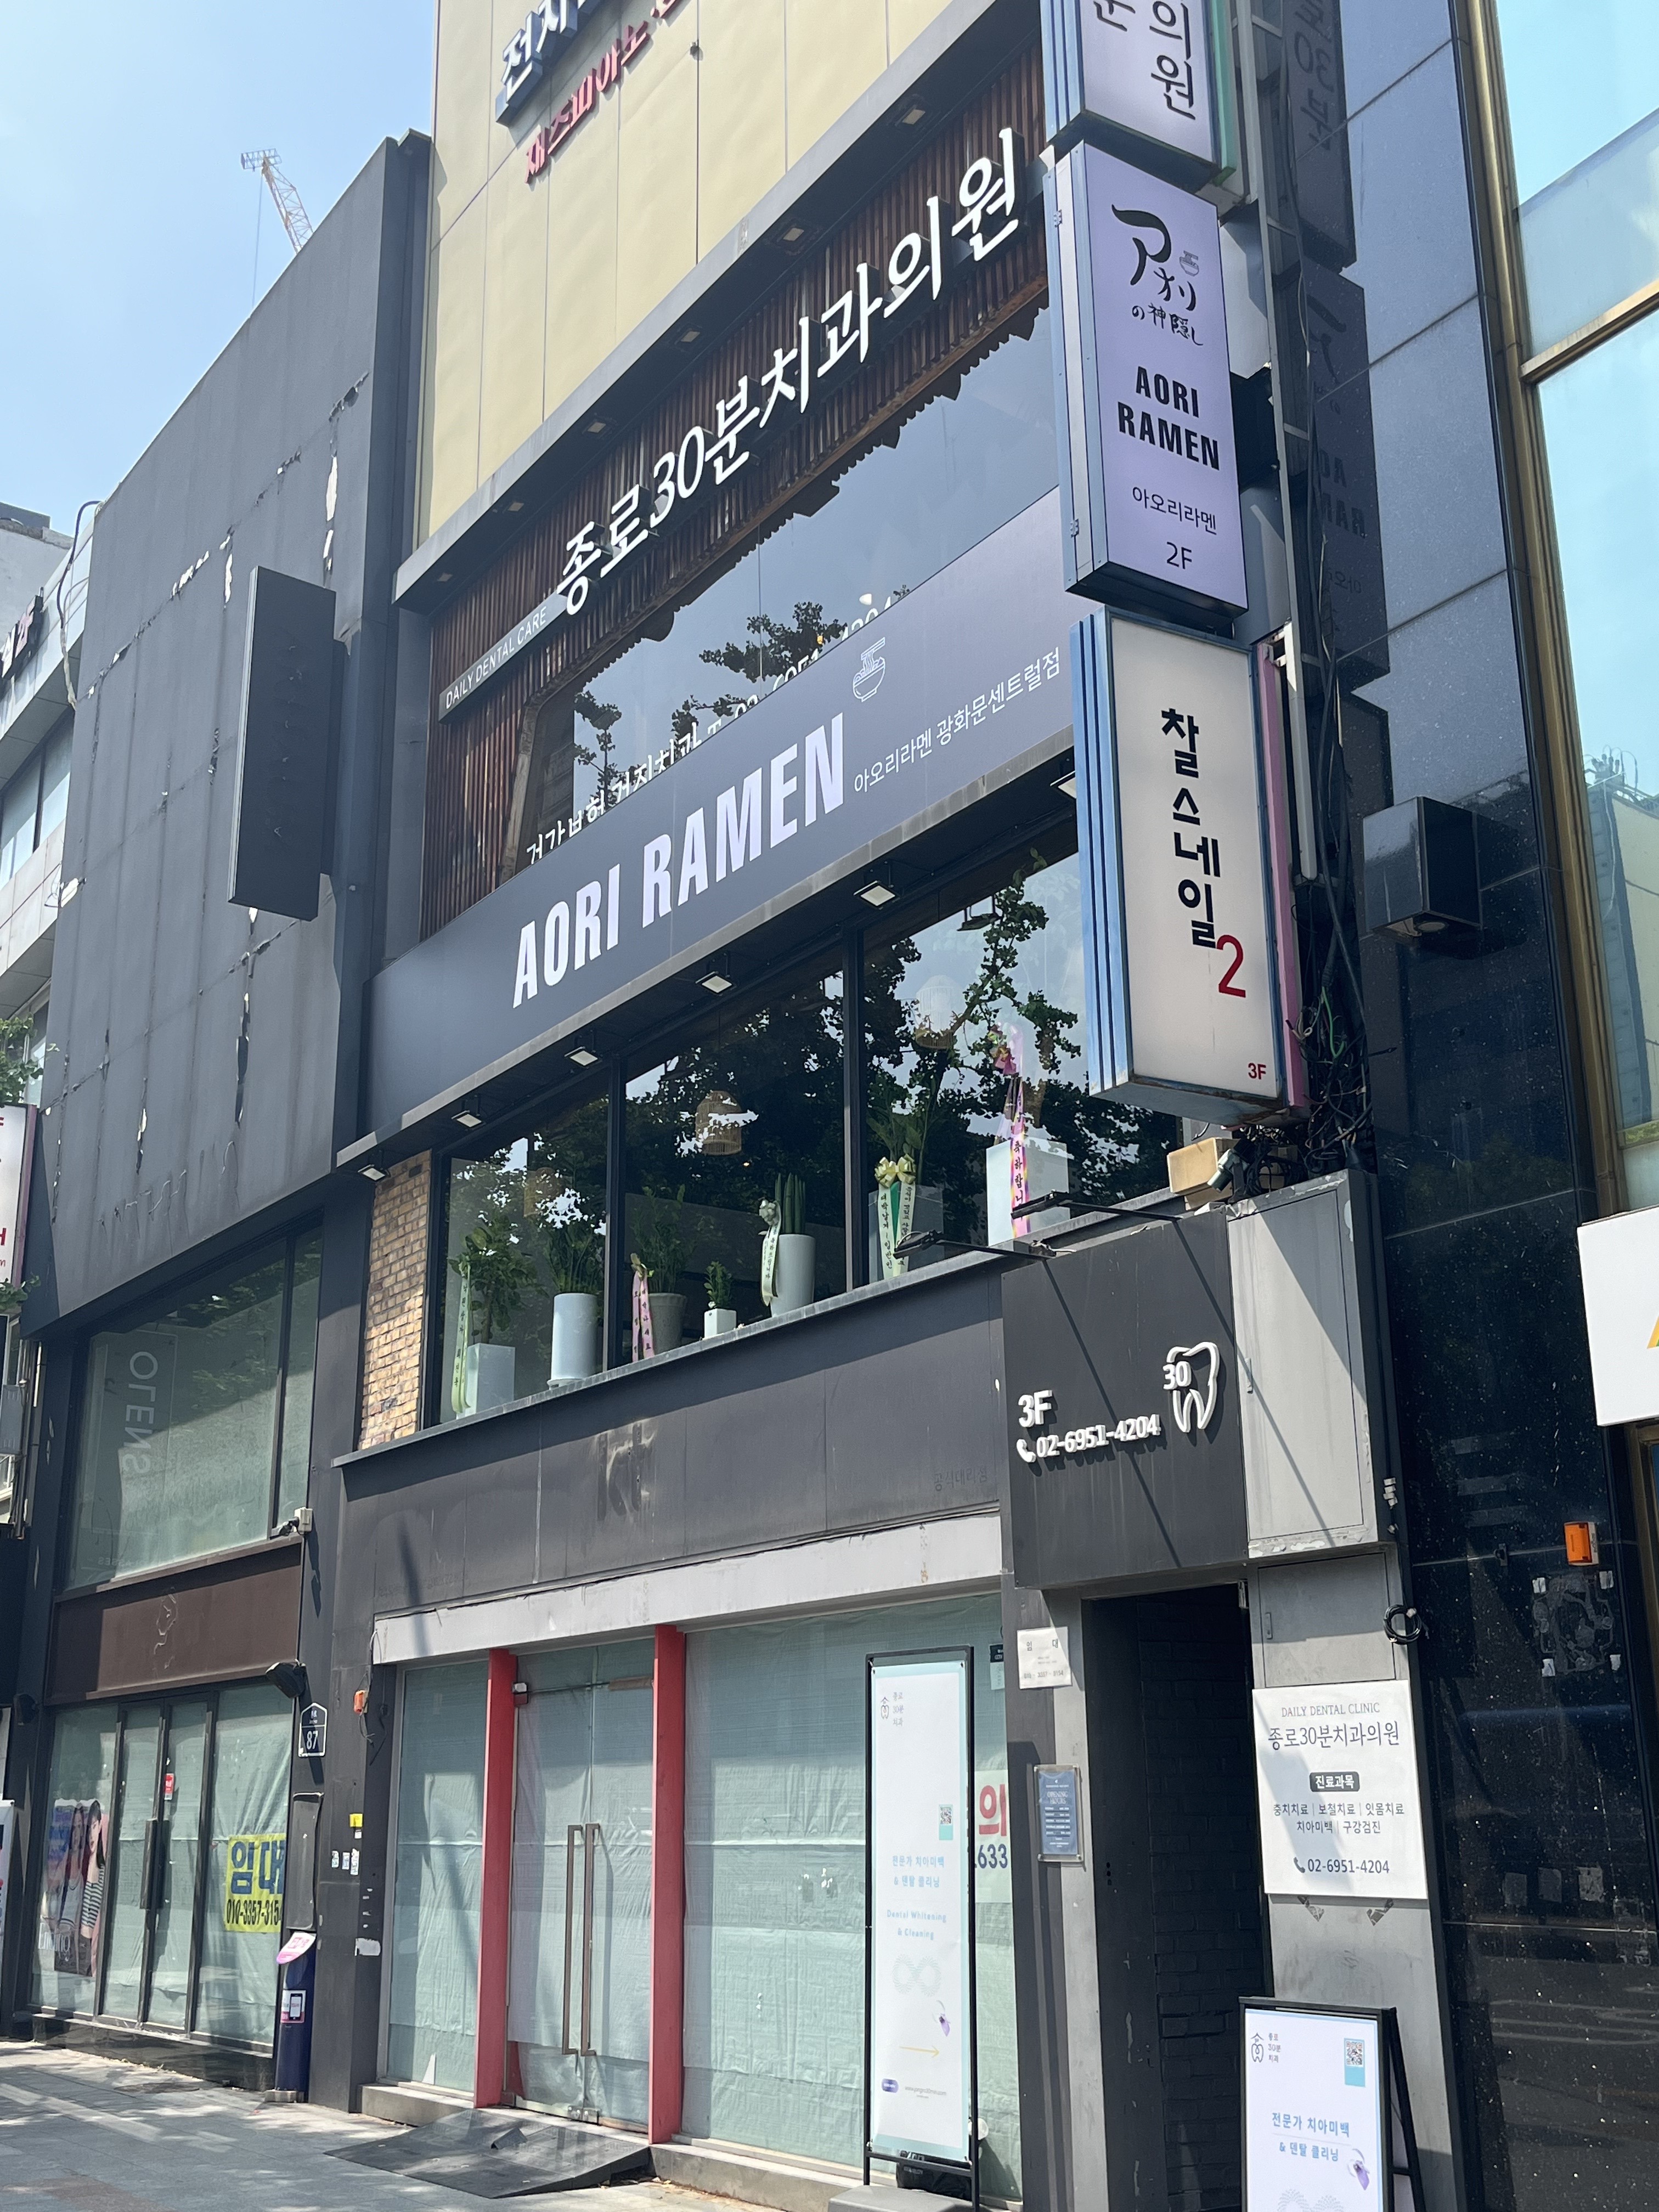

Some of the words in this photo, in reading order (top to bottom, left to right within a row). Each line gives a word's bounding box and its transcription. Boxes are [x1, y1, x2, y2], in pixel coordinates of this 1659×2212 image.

[557, 128, 1020, 616] 종로30분치과의원
[1136, 366, 1199, 418] AORI
[1118, 401, 1220, 471] RAMEN
[1132, 486, 1217, 535] 아오리라멘
[1166, 541, 1193, 570] 2F
[446, 671, 473, 710] DAILY
[476, 637, 515, 684] DENTAL
[517, 606, 547, 645] CARE
[854, 729, 933, 794] 아오리라멘
[936, 647, 1060, 747] 광화문센트럴점
[513, 863, 620, 1008] AORI
[642, 712, 844, 929] RAMEN
[1247, 1062, 1267, 1081] 3F
[1163, 1361, 1192, 1390] 30
[1018, 1390, 1053, 1428] 3F
[1036, 1414, 1163, 1459] 02-6951-4204
[1282, 1705, 1306, 1718] DAILY
[1310, 1704, 1346, 1717] DENTAL
[1348, 1702, 1380, 1715] CLINIC
[306, 1730, 318, 1750] 87
[1267, 1720, 1400, 1751] 종로30분치과의원
[1314, 1775, 1355, 1789] 진료과목
[1273, 1803, 1308, 1816] 충치치료
[1318, 1803, 1355, 1816] 보철치료
[1365, 1803, 1405, 1816] 잇몸치료
[1296, 1820, 1334, 1833] 치아미백
[1342, 1820, 1381, 1834] 구강검진
[231, 1841, 286, 1895] 임대
[892, 1855, 913, 1867] 전문가
[916, 1856, 945, 1869] 치아미백
[1307, 1858, 1390, 1874] 02-6951-4204
[227, 1899, 281, 1926] 010-3357-315
[887, 1909, 909, 1918] Dental
[911, 1911, 947, 1923] Whitening
[905, 1928, 935, 1940] Cleaning
[1268, 2044, 1282, 2053] 30분
[1272, 2112, 1302, 2130] 전문가
[1307, 2117, 1350, 2138] 치아미백
[1279, 2142, 1286, 2152] &
[1289, 2142, 1308, 2157] 덴탈
[1311, 2145, 1339, 2162] 클리닝
